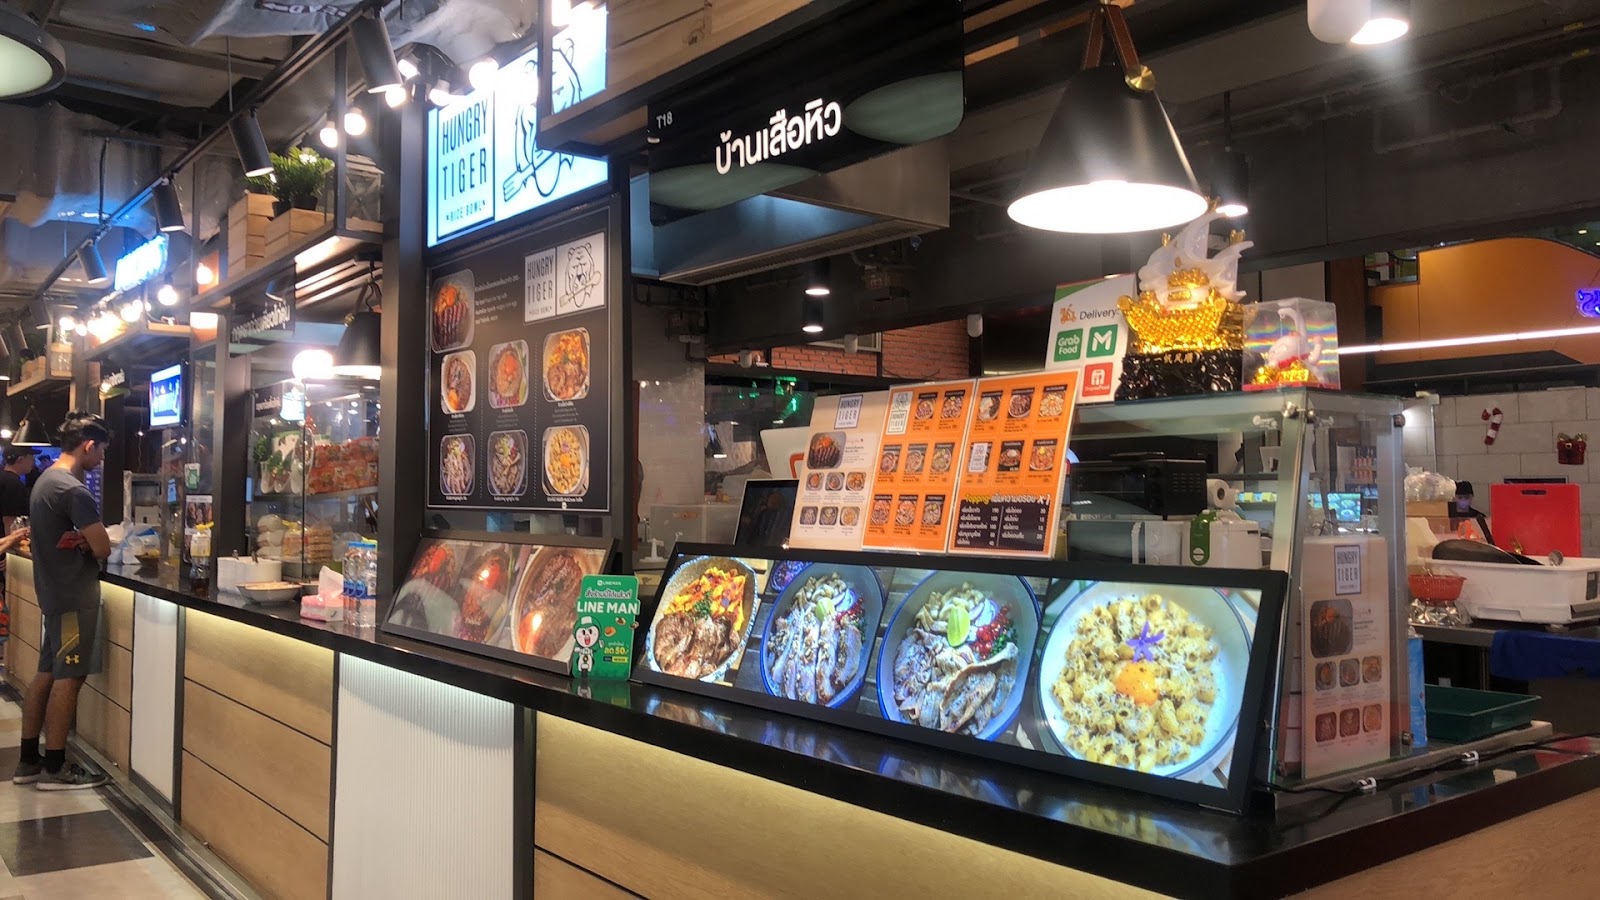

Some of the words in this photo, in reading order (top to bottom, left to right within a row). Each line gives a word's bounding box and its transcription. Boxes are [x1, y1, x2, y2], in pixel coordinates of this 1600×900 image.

[443, 99, 488, 157] HUNGRY
[656, 111, 673, 129] T18
[715, 98, 841, 175] บ้านเสือหิว
[443, 147, 487, 200] TIGER
[450, 208, 464, 222] RICE
[466, 201, 482, 218] BOWL
[527, 255, 554, 281] HUNGRY
[527, 280, 553, 305] TIGER
[1058, 335, 1080, 347] Grab
[1058, 346, 1078, 354] Food
[838, 410, 857, 420] TIGER
[1338, 568, 1358, 581] TIGER
[577, 601, 604, 612] LINE
[607, 602, 638, 614] MAN
